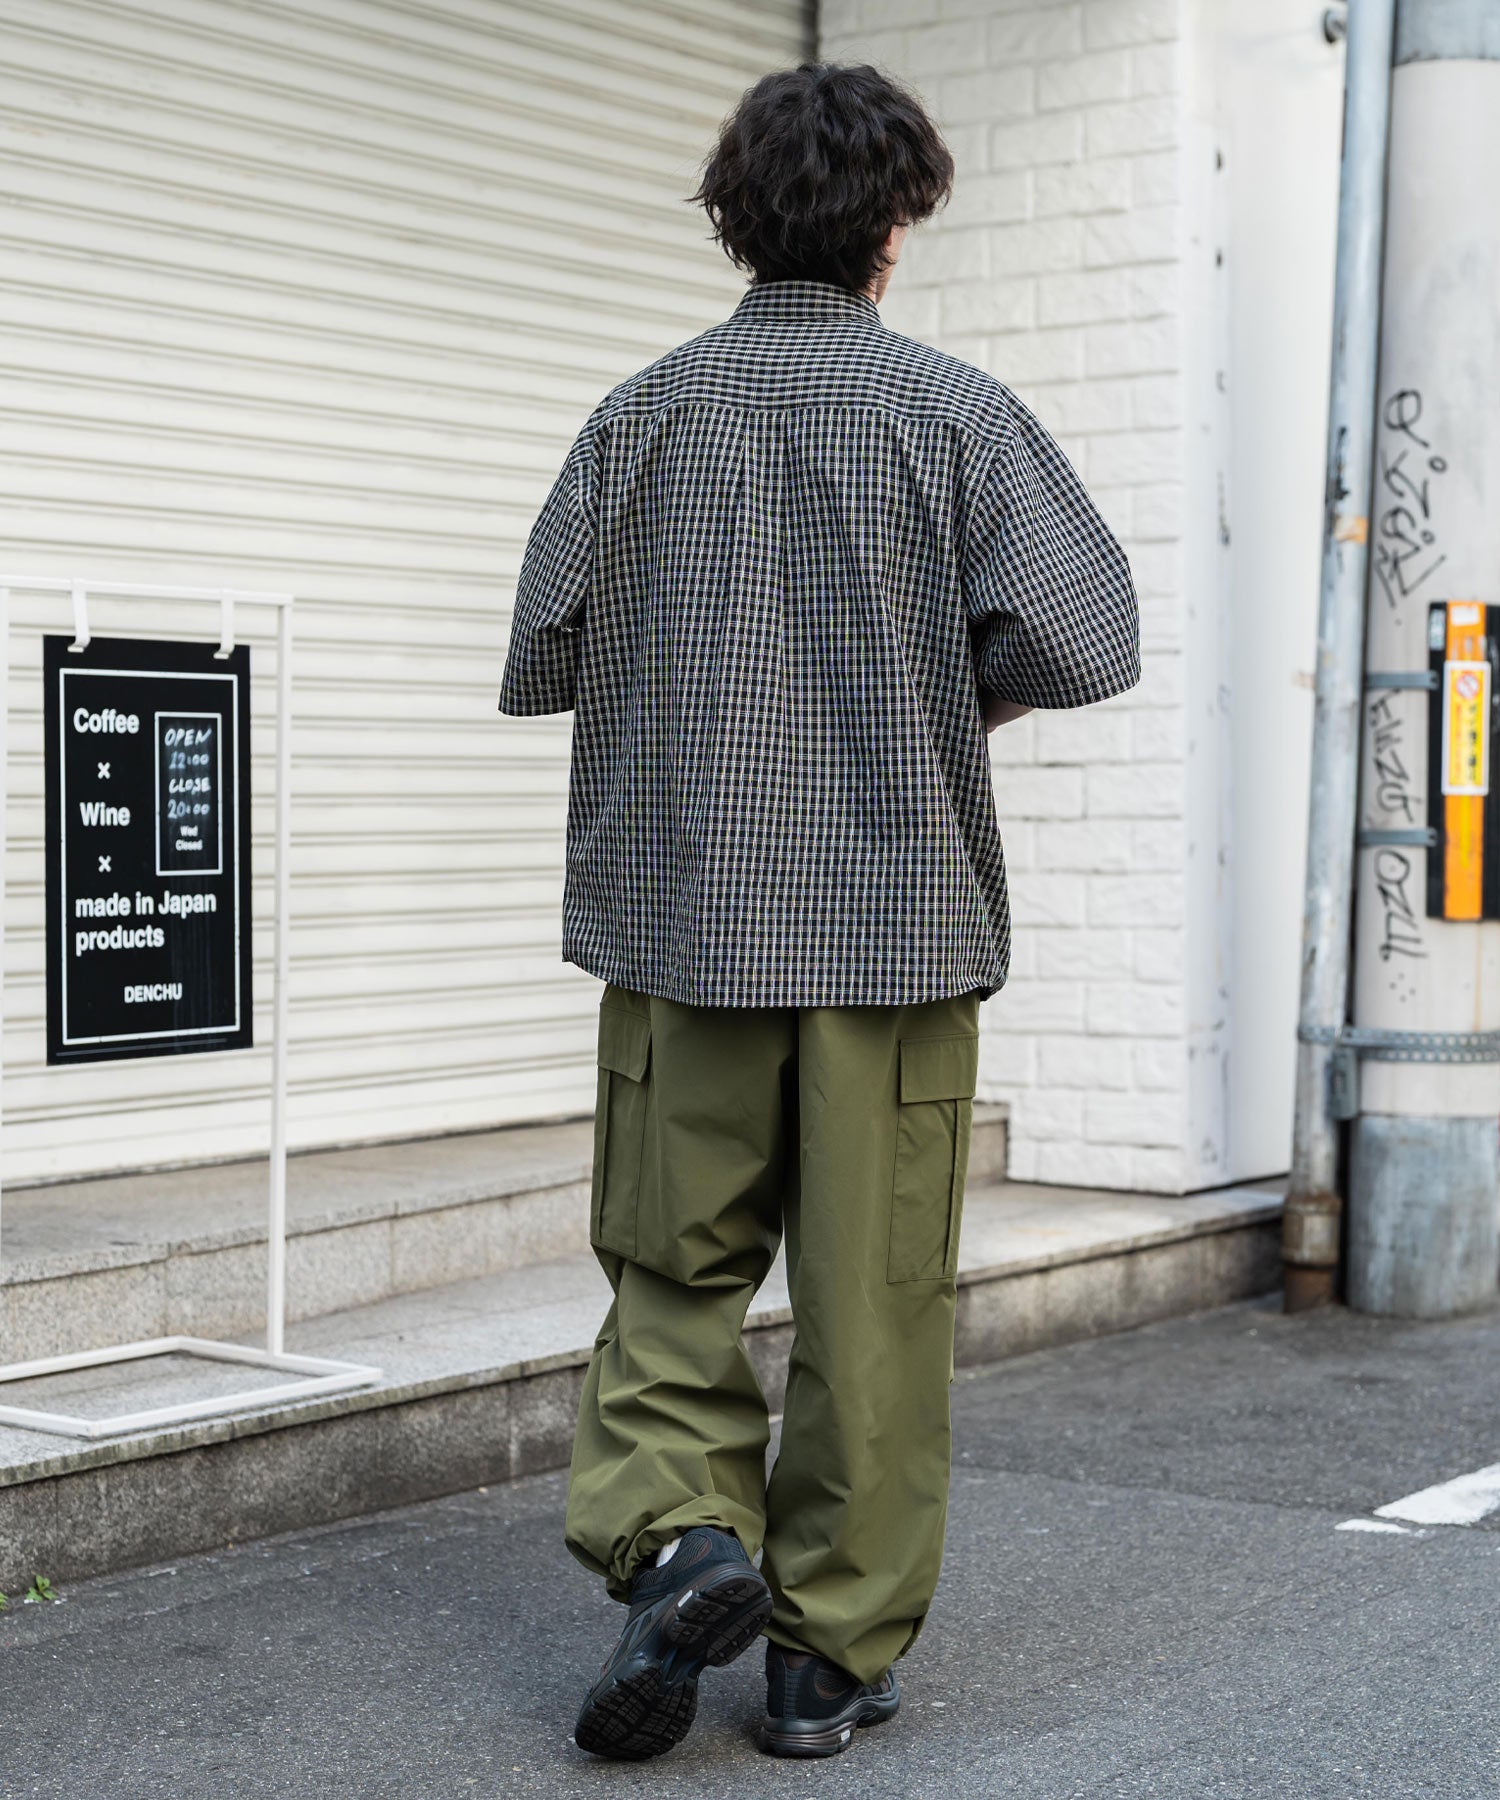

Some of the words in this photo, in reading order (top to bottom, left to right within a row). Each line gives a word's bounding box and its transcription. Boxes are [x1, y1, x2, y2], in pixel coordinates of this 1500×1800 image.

[73, 708, 140, 734] Coffee
[164, 727, 212, 748] OPEN
[168, 776, 212, 796] CLOSE
[80, 801, 131, 827] Wine
[167, 798, 211, 820] 20:00
[175, 839, 203, 852] Closed
[75, 892, 131, 918] made
[135, 890, 154, 916] in
[158, 889, 217, 920] Japan
[75, 924, 165, 958] products
[123, 982, 183, 1004] DENCHU
